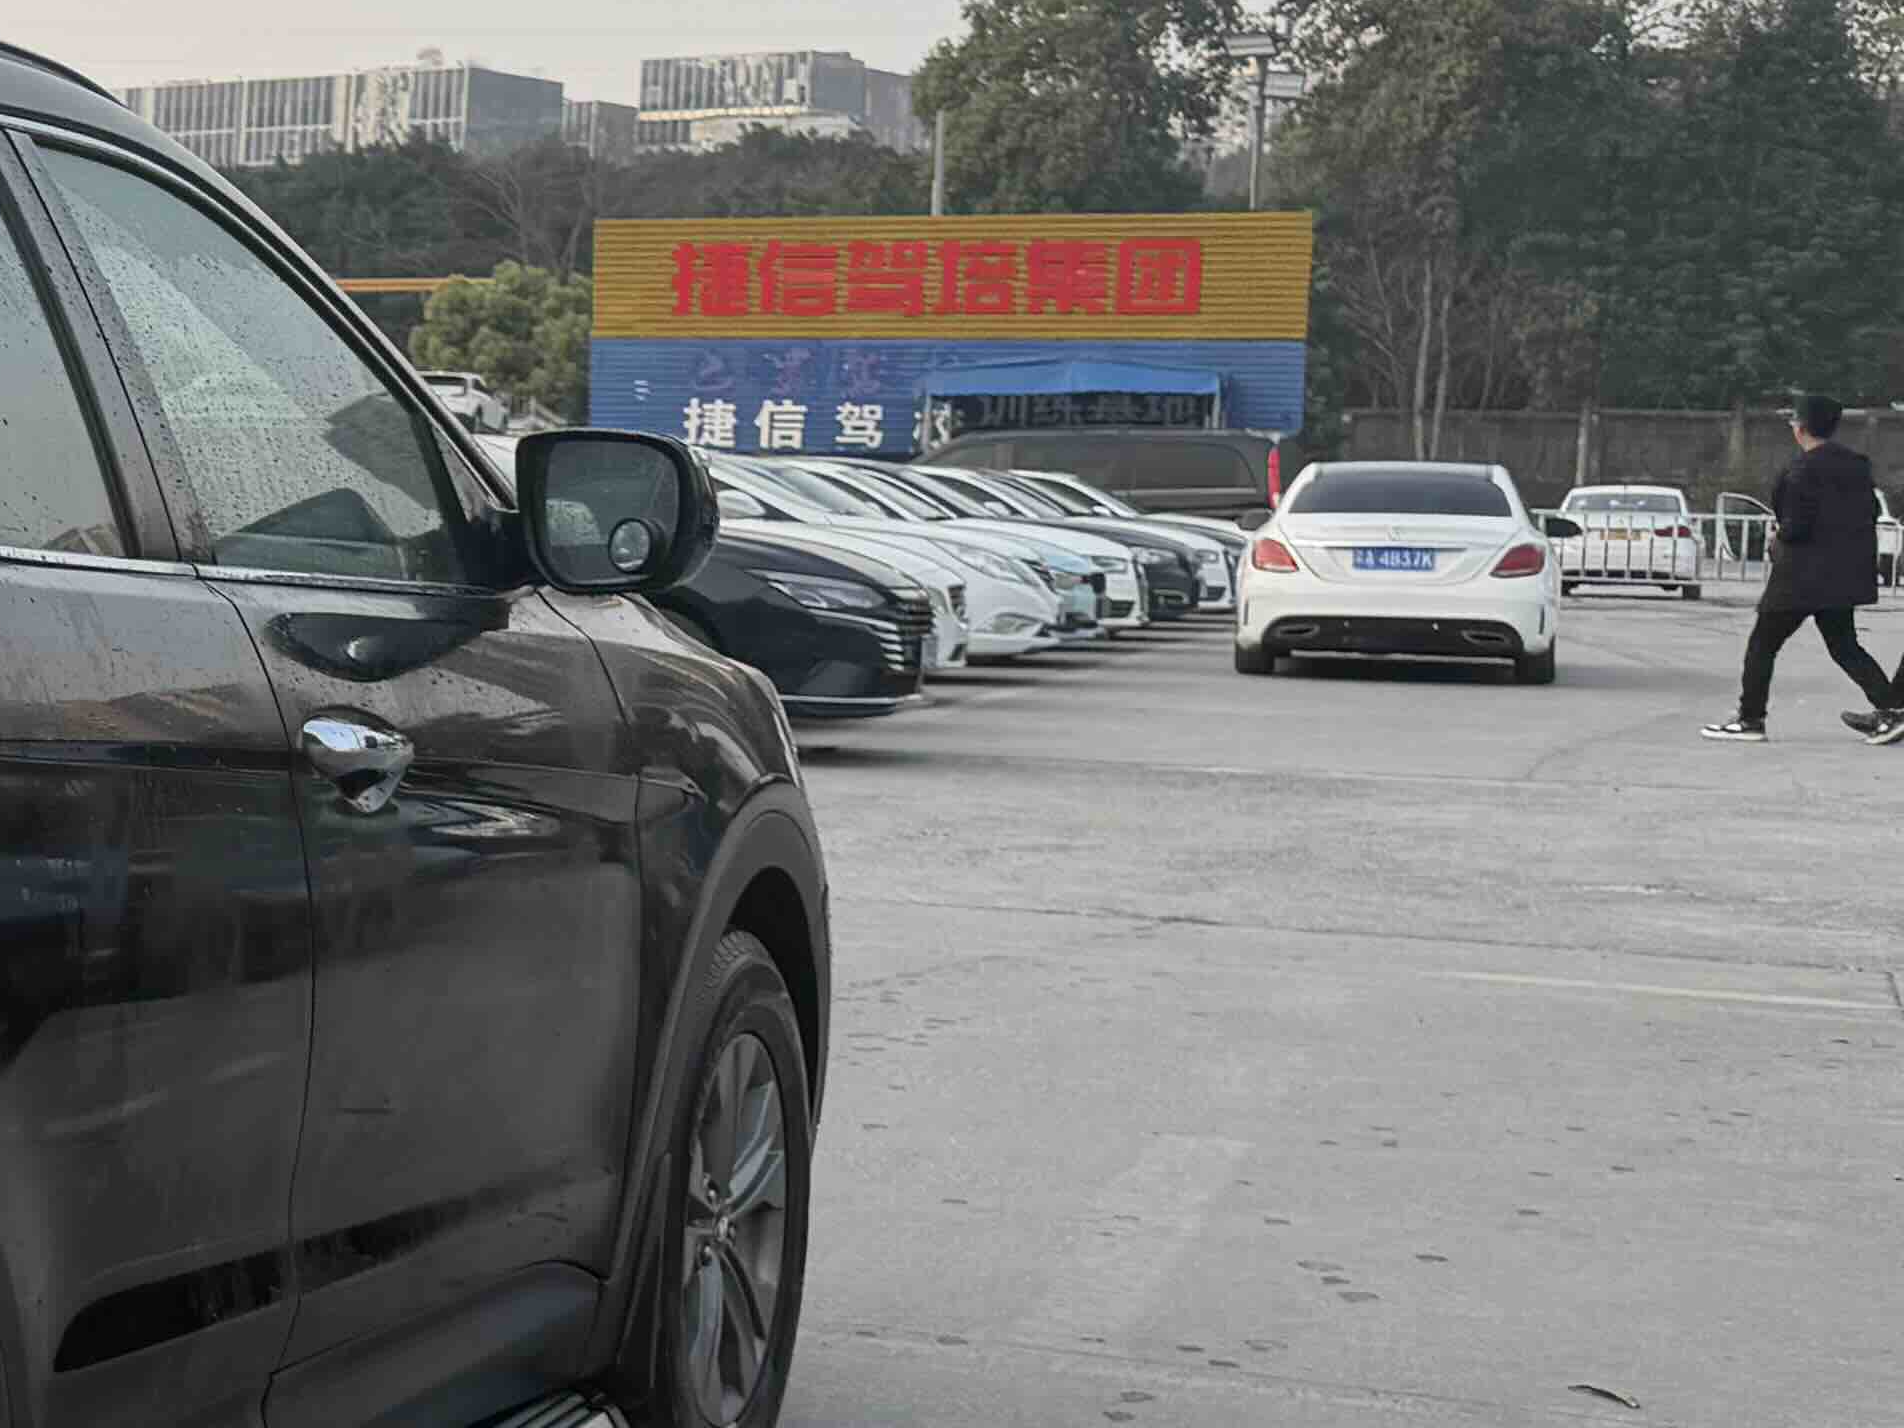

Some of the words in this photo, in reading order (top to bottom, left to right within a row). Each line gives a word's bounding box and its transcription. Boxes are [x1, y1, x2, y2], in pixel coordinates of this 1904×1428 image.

[672, 239, 1201, 318] 捷信驾培集团
